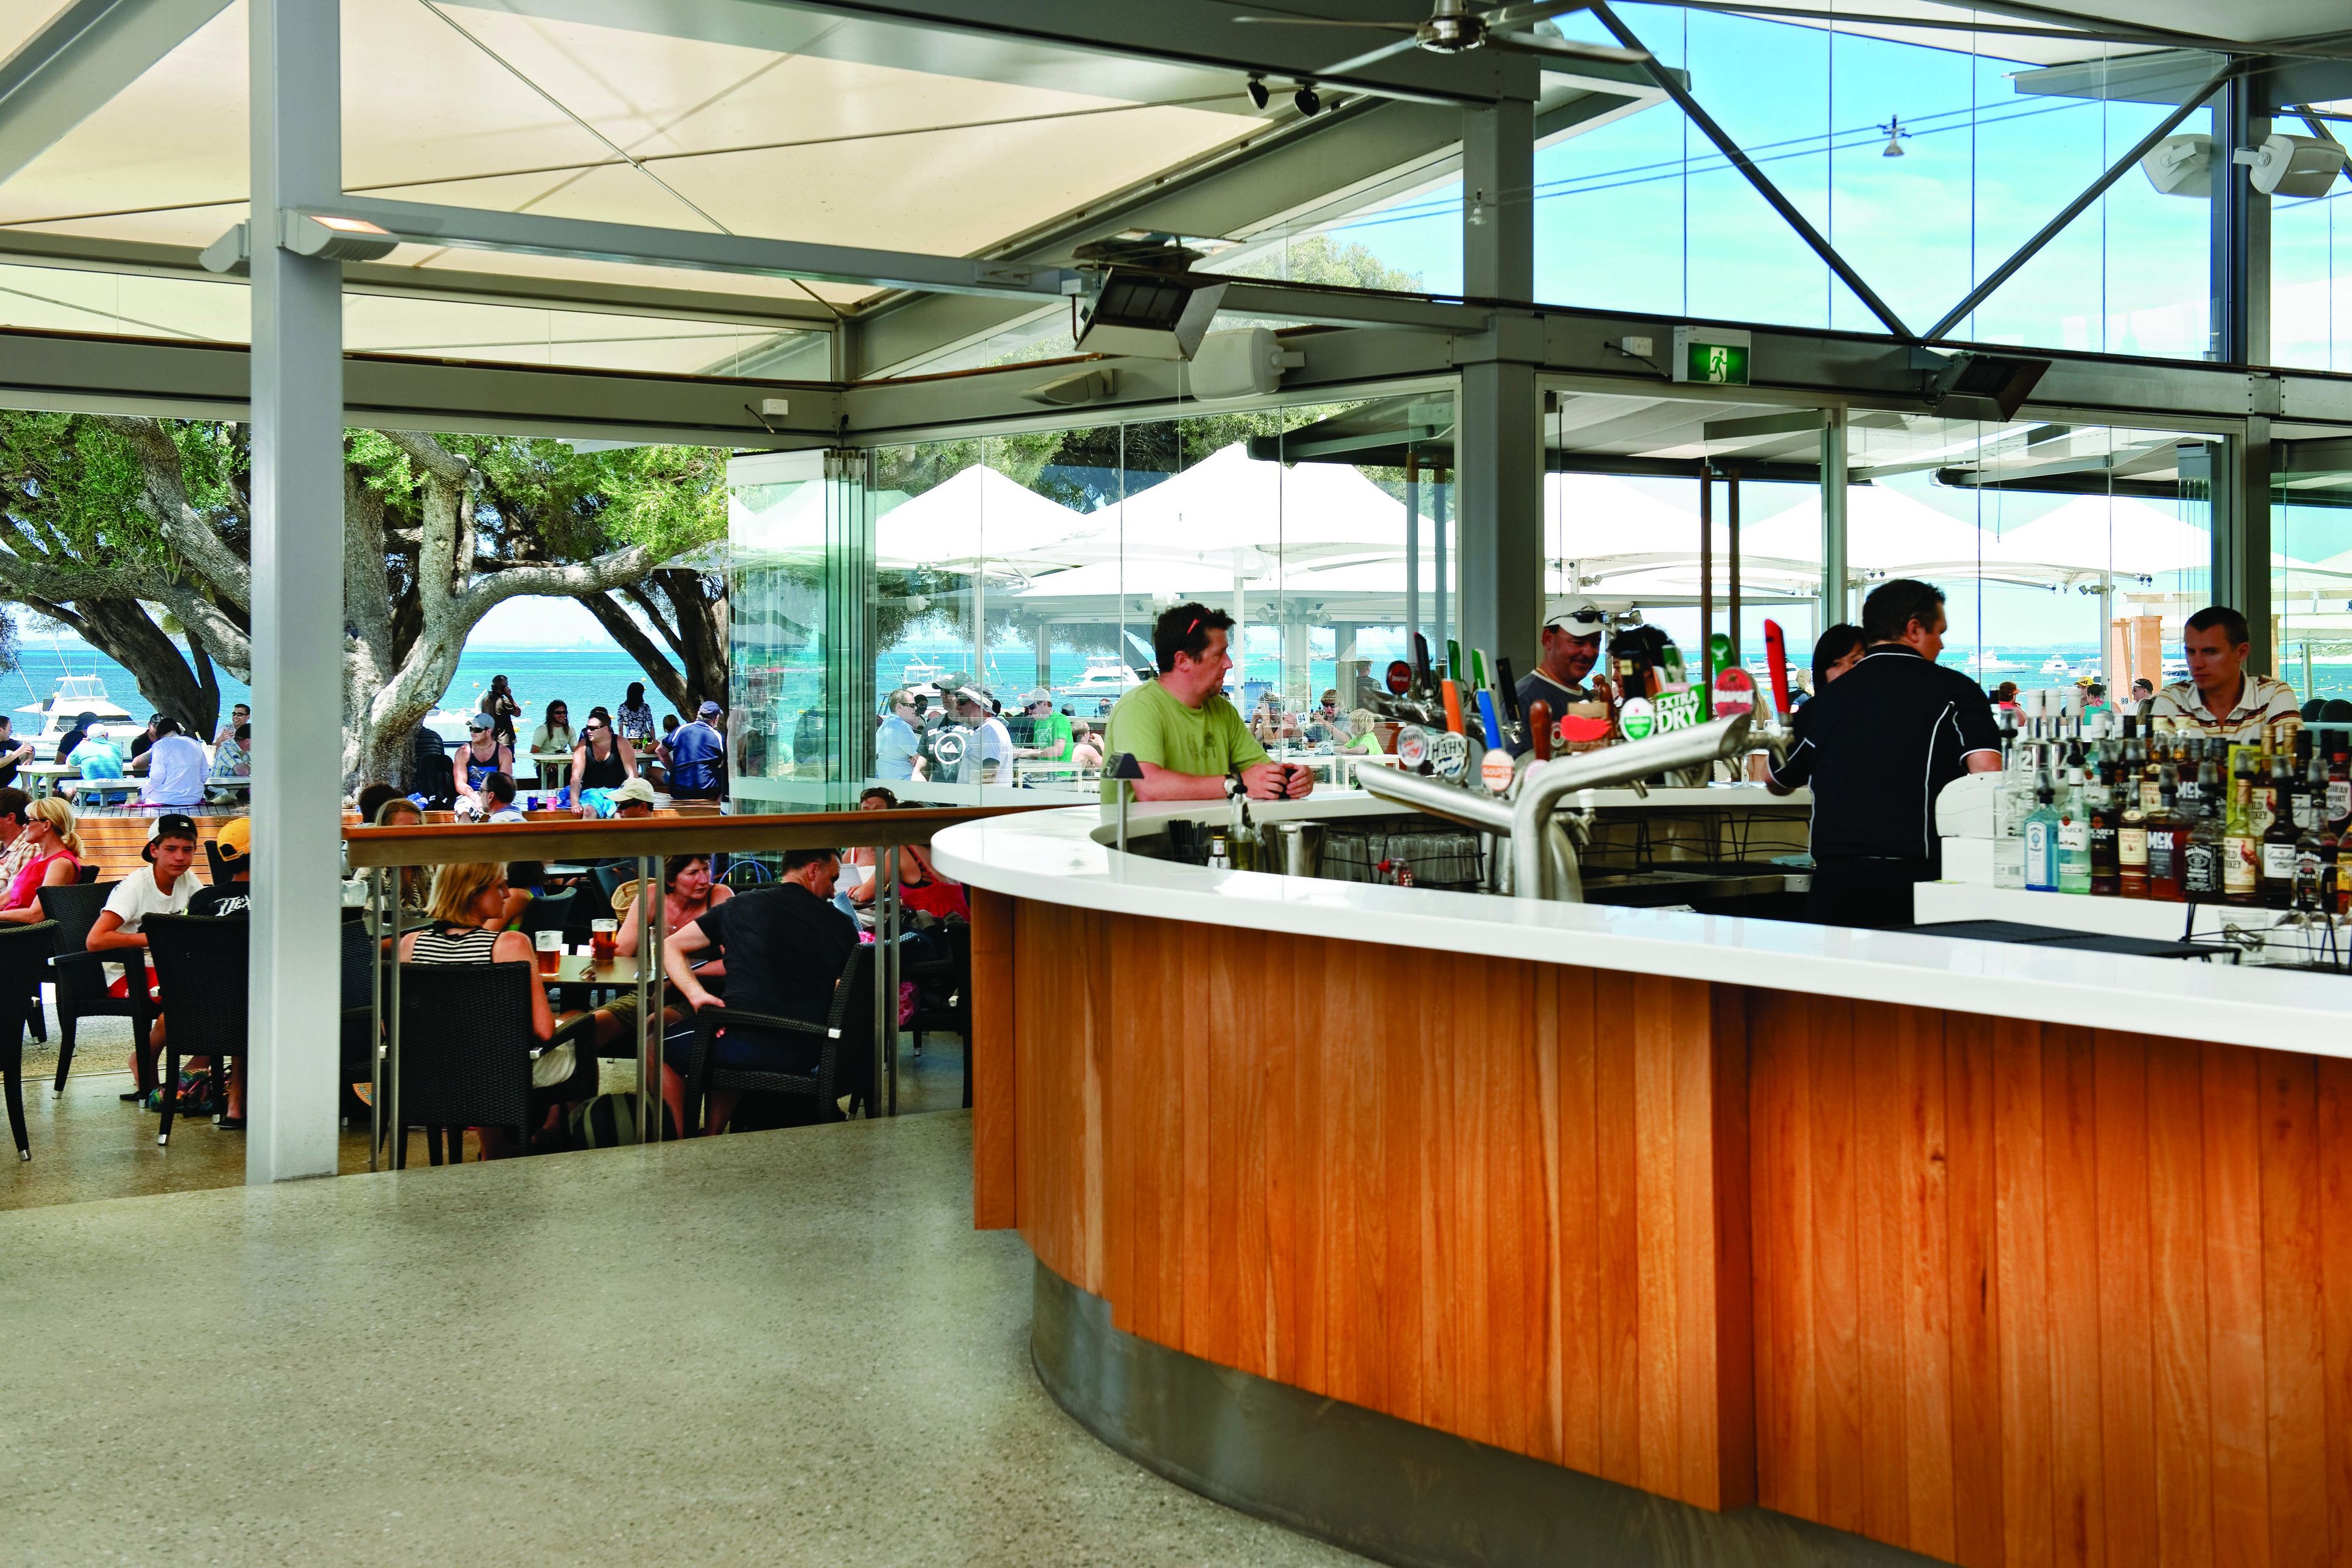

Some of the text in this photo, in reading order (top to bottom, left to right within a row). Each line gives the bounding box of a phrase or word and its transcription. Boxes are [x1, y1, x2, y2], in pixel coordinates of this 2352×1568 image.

[1656, 690, 1699, 710] EXTRA
[1298, 714, 1306, 723] 94
[1656, 702, 1700, 734] DRY
[1431, 740, 1465, 758] HAHN
